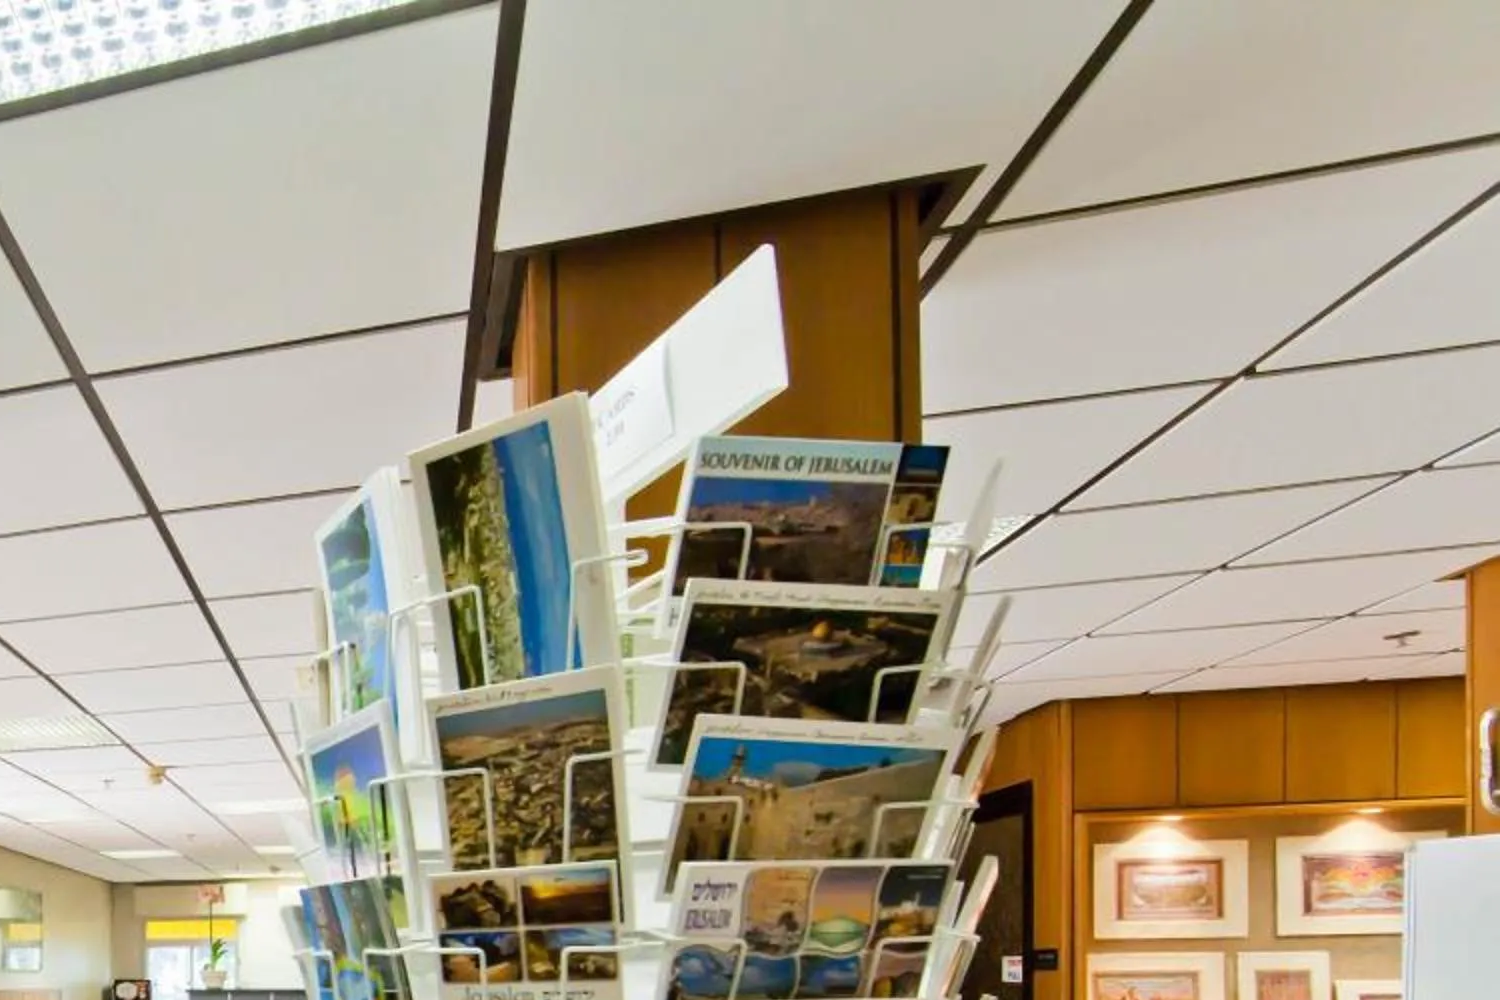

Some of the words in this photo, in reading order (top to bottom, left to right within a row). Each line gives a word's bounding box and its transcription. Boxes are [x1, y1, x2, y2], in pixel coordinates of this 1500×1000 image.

[699, 453, 780, 472] SOUVENIR
[784, 456, 804, 472] OF
[808, 456, 893, 475] JERUSALEM
